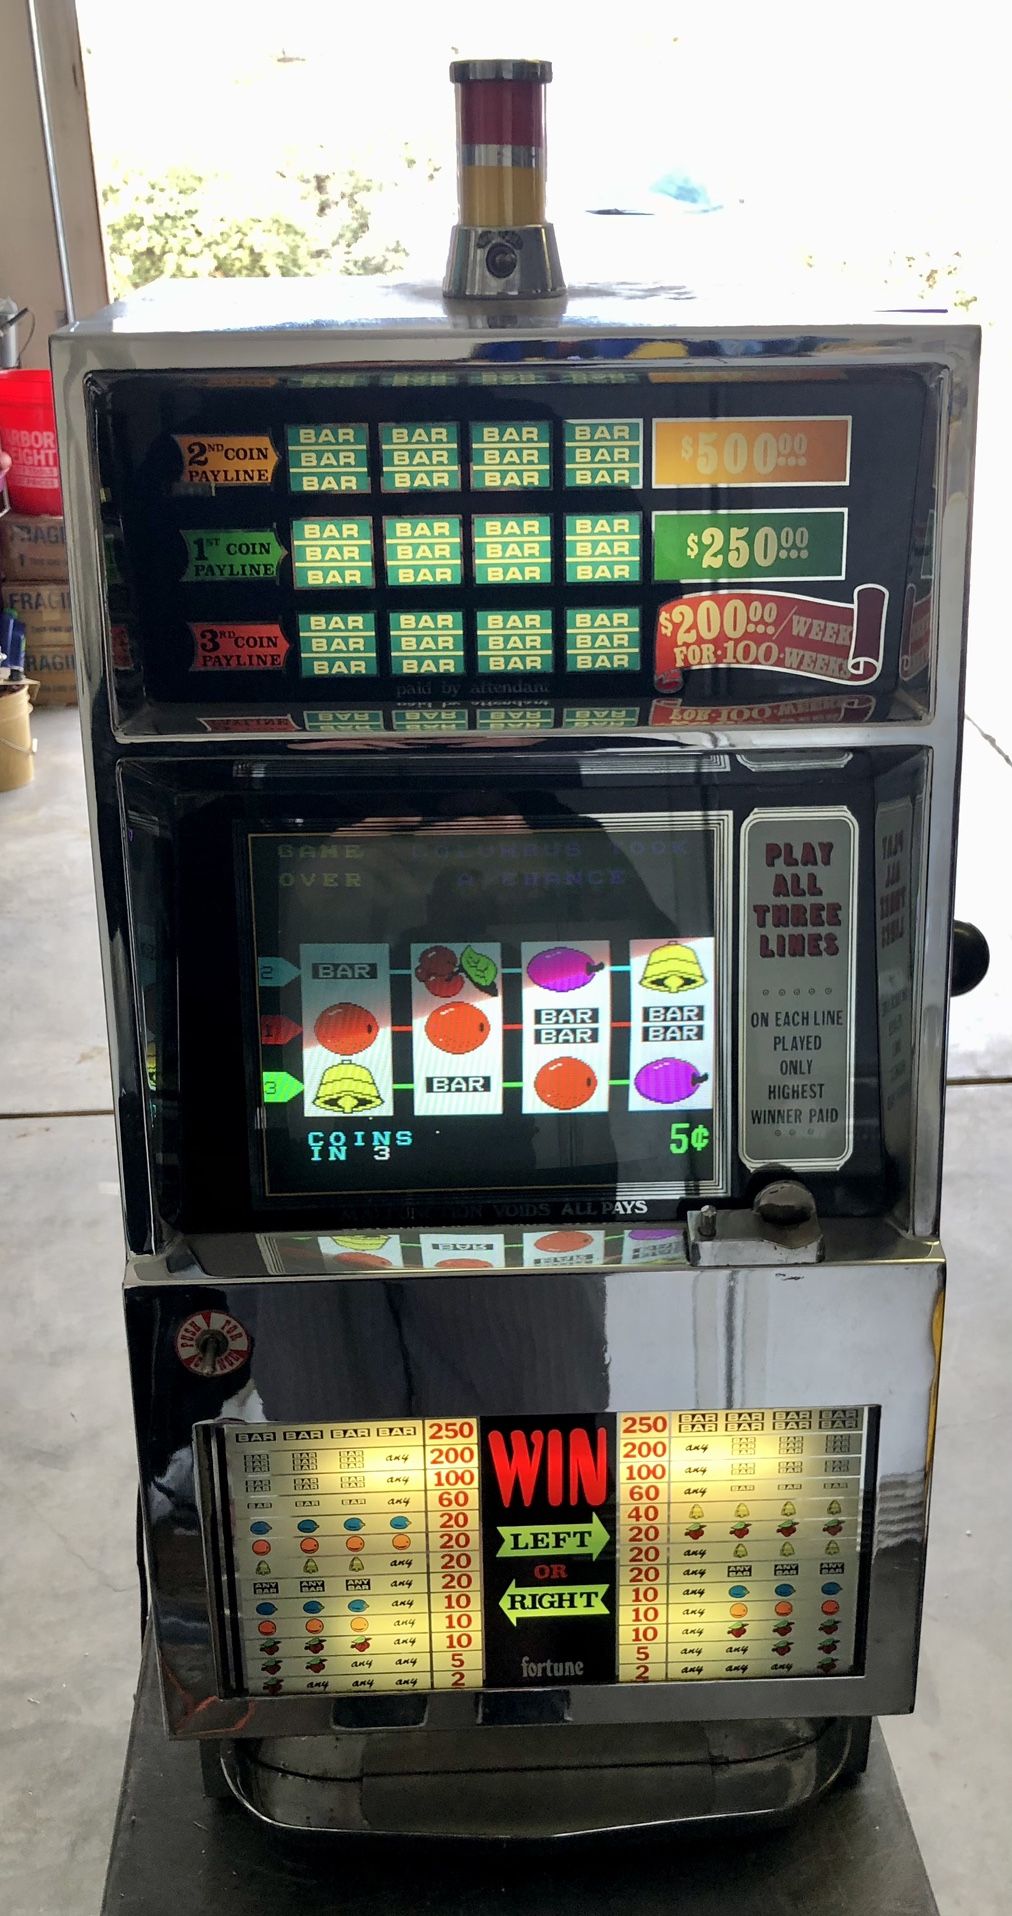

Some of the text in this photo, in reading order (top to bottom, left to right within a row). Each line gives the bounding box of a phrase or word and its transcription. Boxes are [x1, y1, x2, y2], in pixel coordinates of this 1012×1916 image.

[300, 426, 630, 443] BAR BAR BAR BAR
[187, 442, 269, 466] 2ND COIN
[301, 448, 630, 466] BAR BAR BAR BAR
[188, 469, 269, 482] PAYLINE
[302, 469, 630, 491] BAR BAR BAR BAR
[303, 519, 630, 539] BAR BAR BAR BAR
[193, 538, 271, 561] 1ST COIN
[305, 541, 630, 561] BAR BAR BAR BAR
[194, 564, 274, 577] PAYLINE
[307, 565, 630, 584] BAR BAR BAR BAR
[310, 613, 629, 630] BAR BAR BAR BAR
[200, 629, 279, 653] 3RD COIN
[312, 634, 629, 652] BAR BAR BAR BAR
[202, 654, 281, 667] PAYLINE
[313, 655, 629, 675] BAR BAR BAR BAR
[396, 682, 431, 698] paid
[442, 682, 460, 697] by
[278, 844, 365, 859] GAME
[765, 842, 834, 867] PLAY
[279, 872, 361, 887] OVER
[773, 872, 823, 897] ALL
[753, 902, 842, 928] THREE
[760, 932, 839, 958] LINES
[260, 965, 273, 979] 2
[318, 965, 370, 978] BAR
[540, 1007, 698, 1024] BAR BAR
[751, 1010, 843, 1028] ON EACH LINE
[265, 1024, 273, 1037] 1
[540, 1026, 698, 1043] BAR BAR
[773, 1035, 822, 1051] PLAYED
[780, 1059, 813, 1076] ONLY
[264, 1081, 277, 1094] 3
[432, 1077, 485, 1092] BAR
[768, 1083, 825, 1100] HIGHEST
[751, 1108, 838, 1125] WINNER PAID
[307, 1131, 413, 1146] COINS
[669, 1123, 710, 1154] 5¢
[311, 1145, 391, 1161] IN 3
[561, 1202, 596, 1216] ALL
[602, 1200, 648, 1216] PAYS
[180, 1321, 202, 1348] PUSH
[622, 1416, 668, 1434] 250
[681, 1410, 857, 1423] BAR BAR BAR BAR
[238, 1421, 474, 1443] BAR BAR BAR BAR 250
[680, 1420, 856, 1433] BAR BAR BAR BAR
[385, 1447, 474, 1465] any 200
[623, 1441, 709, 1459] 200 any
[487, 1427, 608, 1508] WIN
[626, 1464, 707, 1481] 100 any
[386, 1469, 475, 1487] any 100
[387, 1491, 469, 1508] any 60
[629, 1484, 707, 1501] 60 any
[439, 1512, 469, 1529] 20
[627, 1505, 659, 1522] 40
[439, 1532, 470, 1549] 20
[510, 1530, 593, 1550] LEFT
[628, 1525, 660, 1543] 20
[390, 1553, 472, 1570] any 20
[628, 1546, 707, 1563] 20 any
[534, 1564, 568, 1580] OR
[629, 1566, 706, 1583] 20 any
[390, 1573, 473, 1590] any 20
[391, 1593, 471, 1610] any 10
[507, 1592, 599, 1610] RIGHT
[632, 1586, 706, 1603] 10 any
[445, 1613, 472, 1629] 10
[632, 1606, 659, 1623] 10
[446, 1633, 472, 1649] 10
[632, 1626, 658, 1642] 10
[451, 1653, 465, 1668] 5
[636, 1646, 650, 1661] 5
[521, 1656, 584, 1678] fortune
[635, 1664, 650, 1680] 2
[451, 1671, 465, 1687] 2
